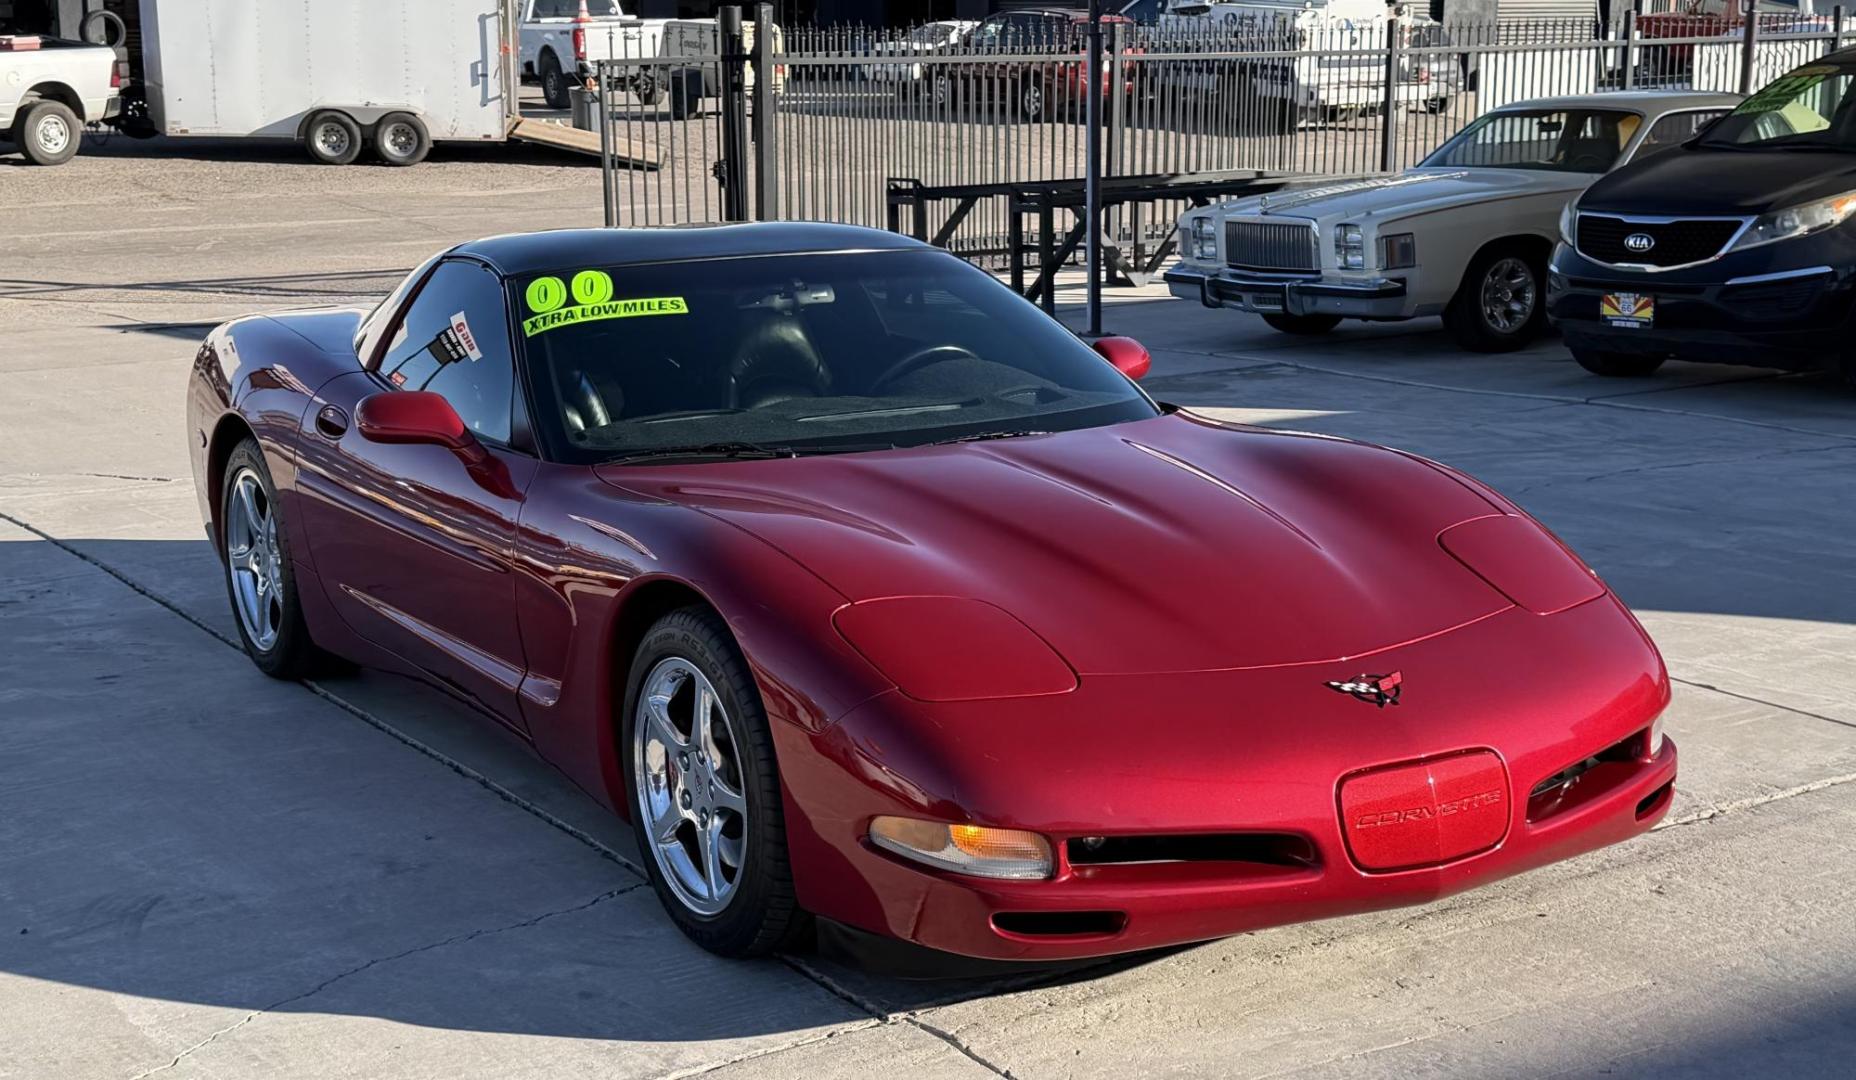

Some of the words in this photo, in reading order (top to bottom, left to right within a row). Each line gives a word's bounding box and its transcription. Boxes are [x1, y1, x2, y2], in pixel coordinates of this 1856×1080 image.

[1627, 236, 1649, 249] KIA
[526, 270, 613, 313] 00
[528, 310, 577, 333] XTRA
[581, 303, 620, 318] LOW
[623, 299, 682, 313] MILES
[1356, 788, 1501, 828] CORVETTE
